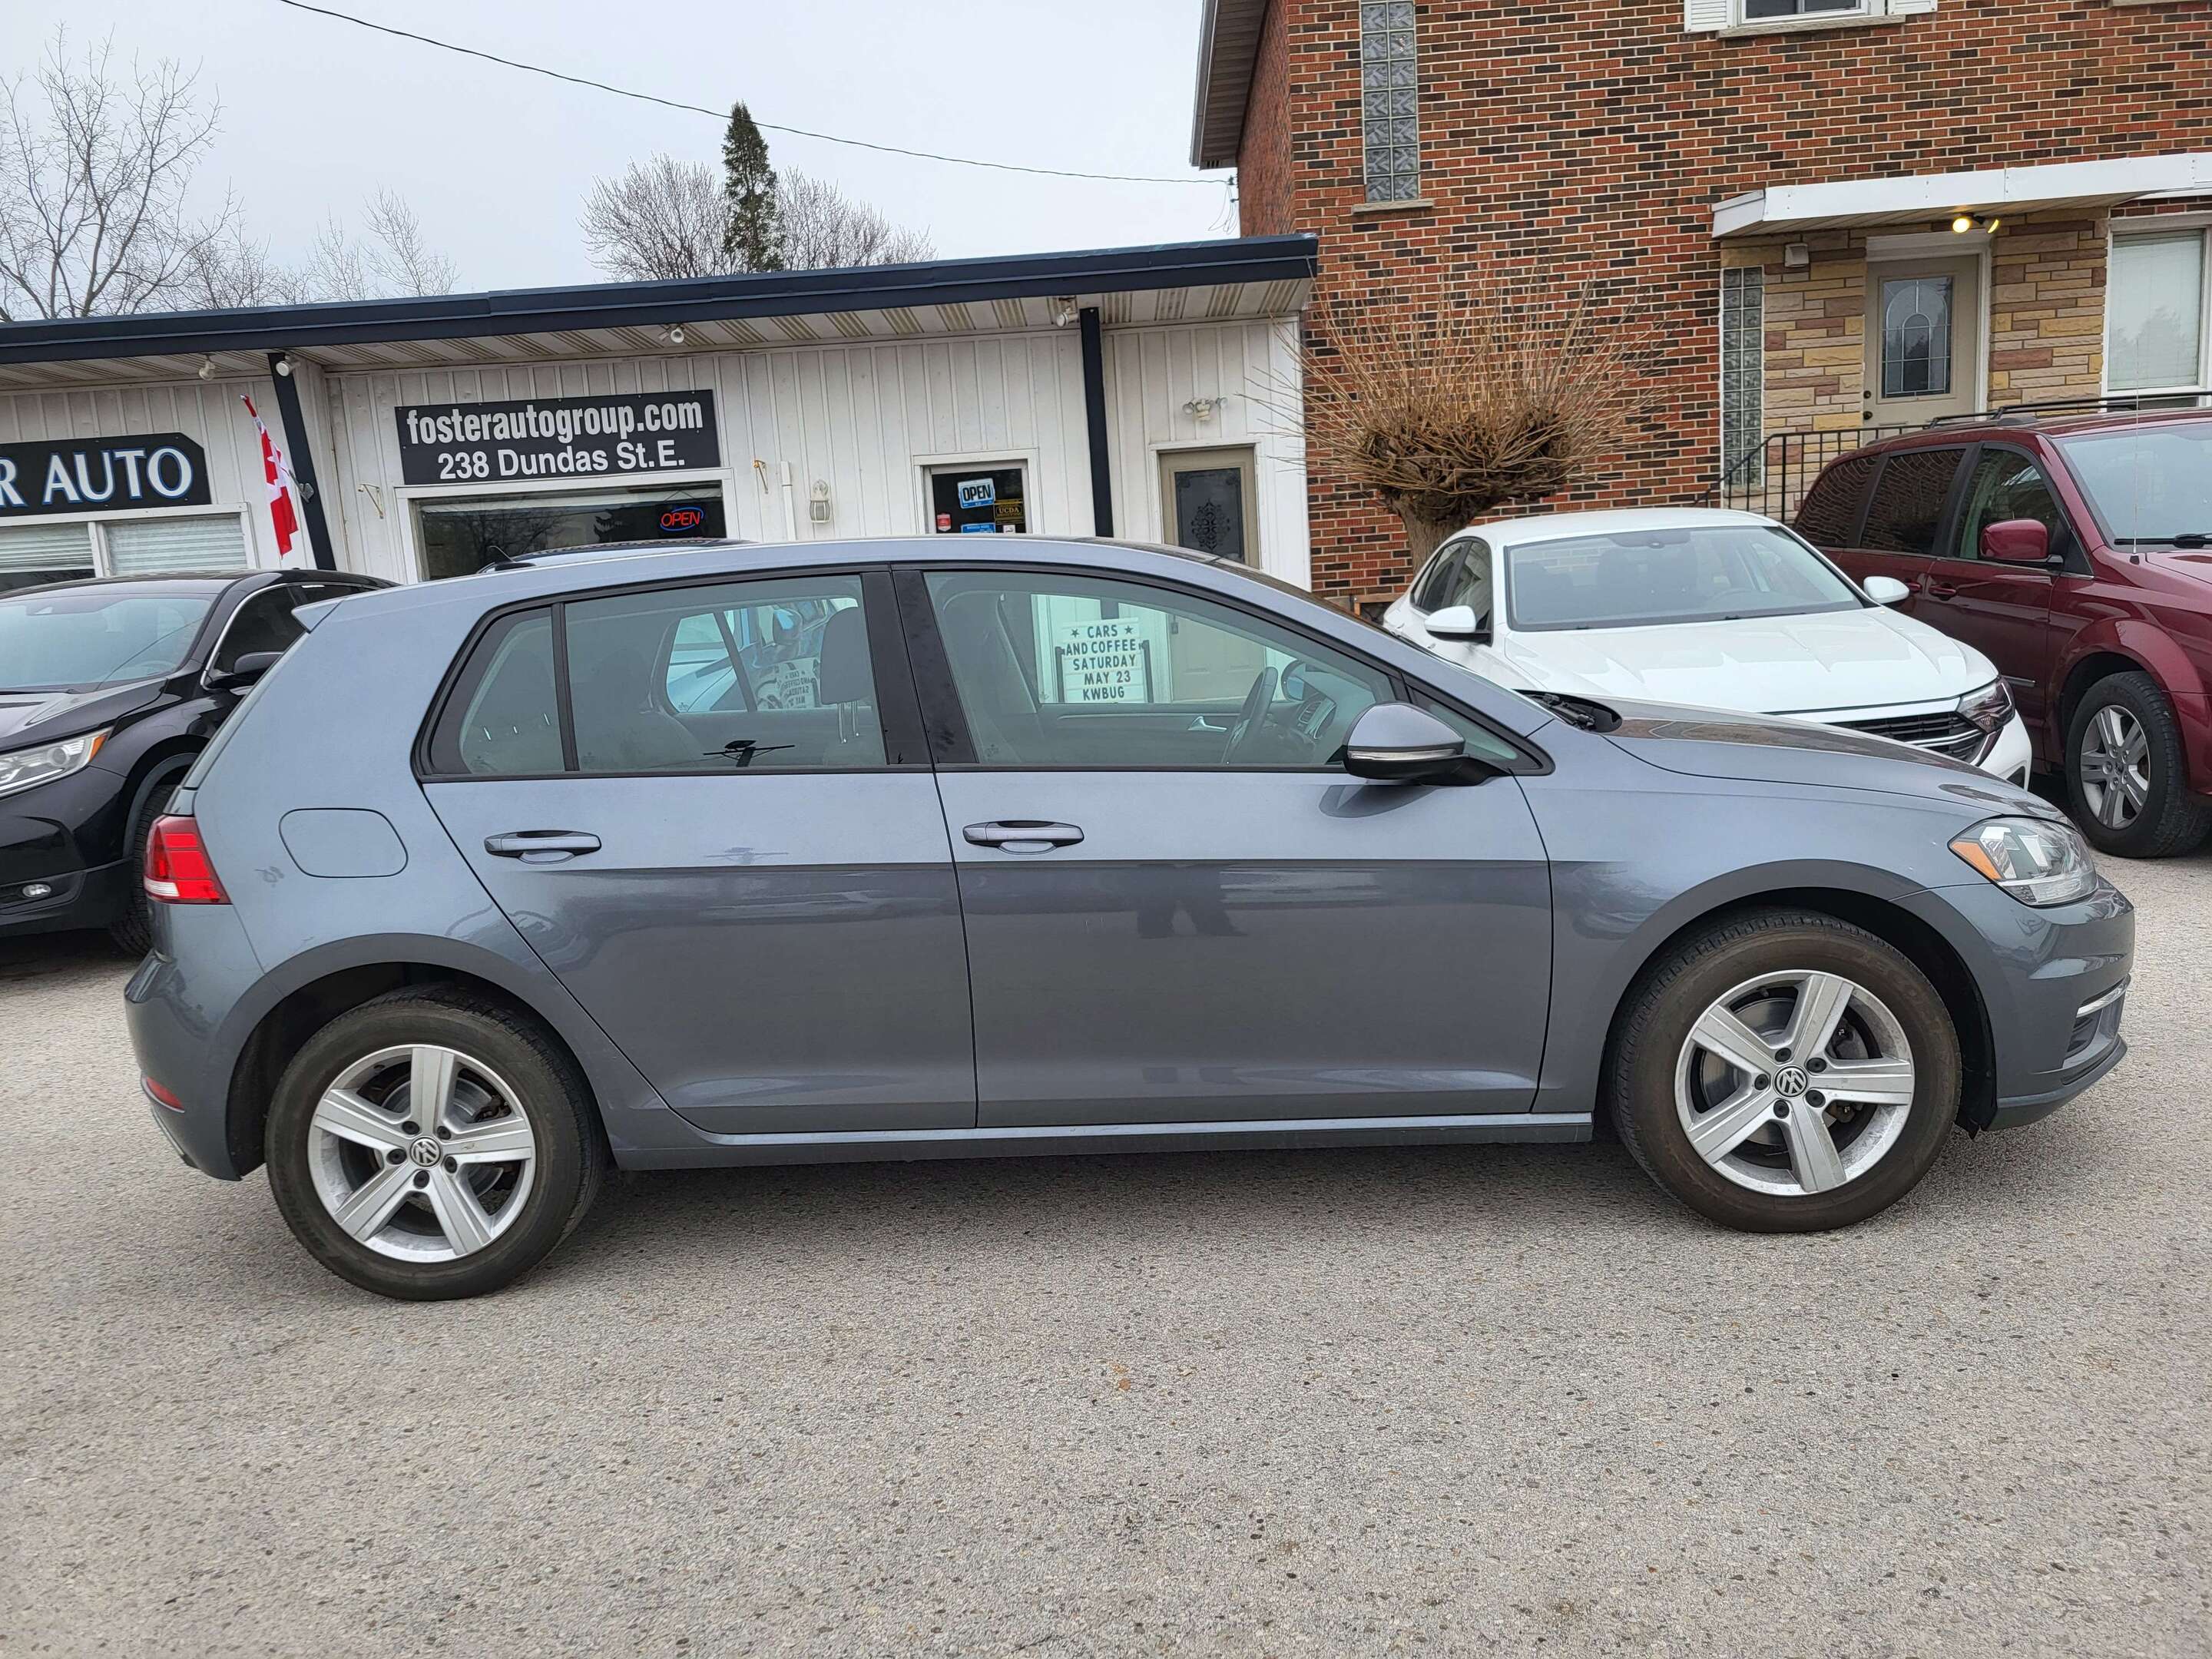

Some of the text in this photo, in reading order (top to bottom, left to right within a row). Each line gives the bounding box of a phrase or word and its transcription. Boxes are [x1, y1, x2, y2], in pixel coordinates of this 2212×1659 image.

[406, 400, 704, 445] fosterautogroup.com
[438, 450, 490, 480] 238
[498, 445, 609, 477] Dundas
[42, 446, 193, 505] AUTO
[962, 484, 991, 502] OPEN
[661, 510, 700, 528] OPEN
[1087, 624, 1118, 639] CARS
[1066, 638, 1137, 656] AND COFFEE
[1072, 654, 1136, 671] SATURDAY
[1084, 670, 1131, 686] MAY 23
[1082, 686, 1125, 701] KWBUG
